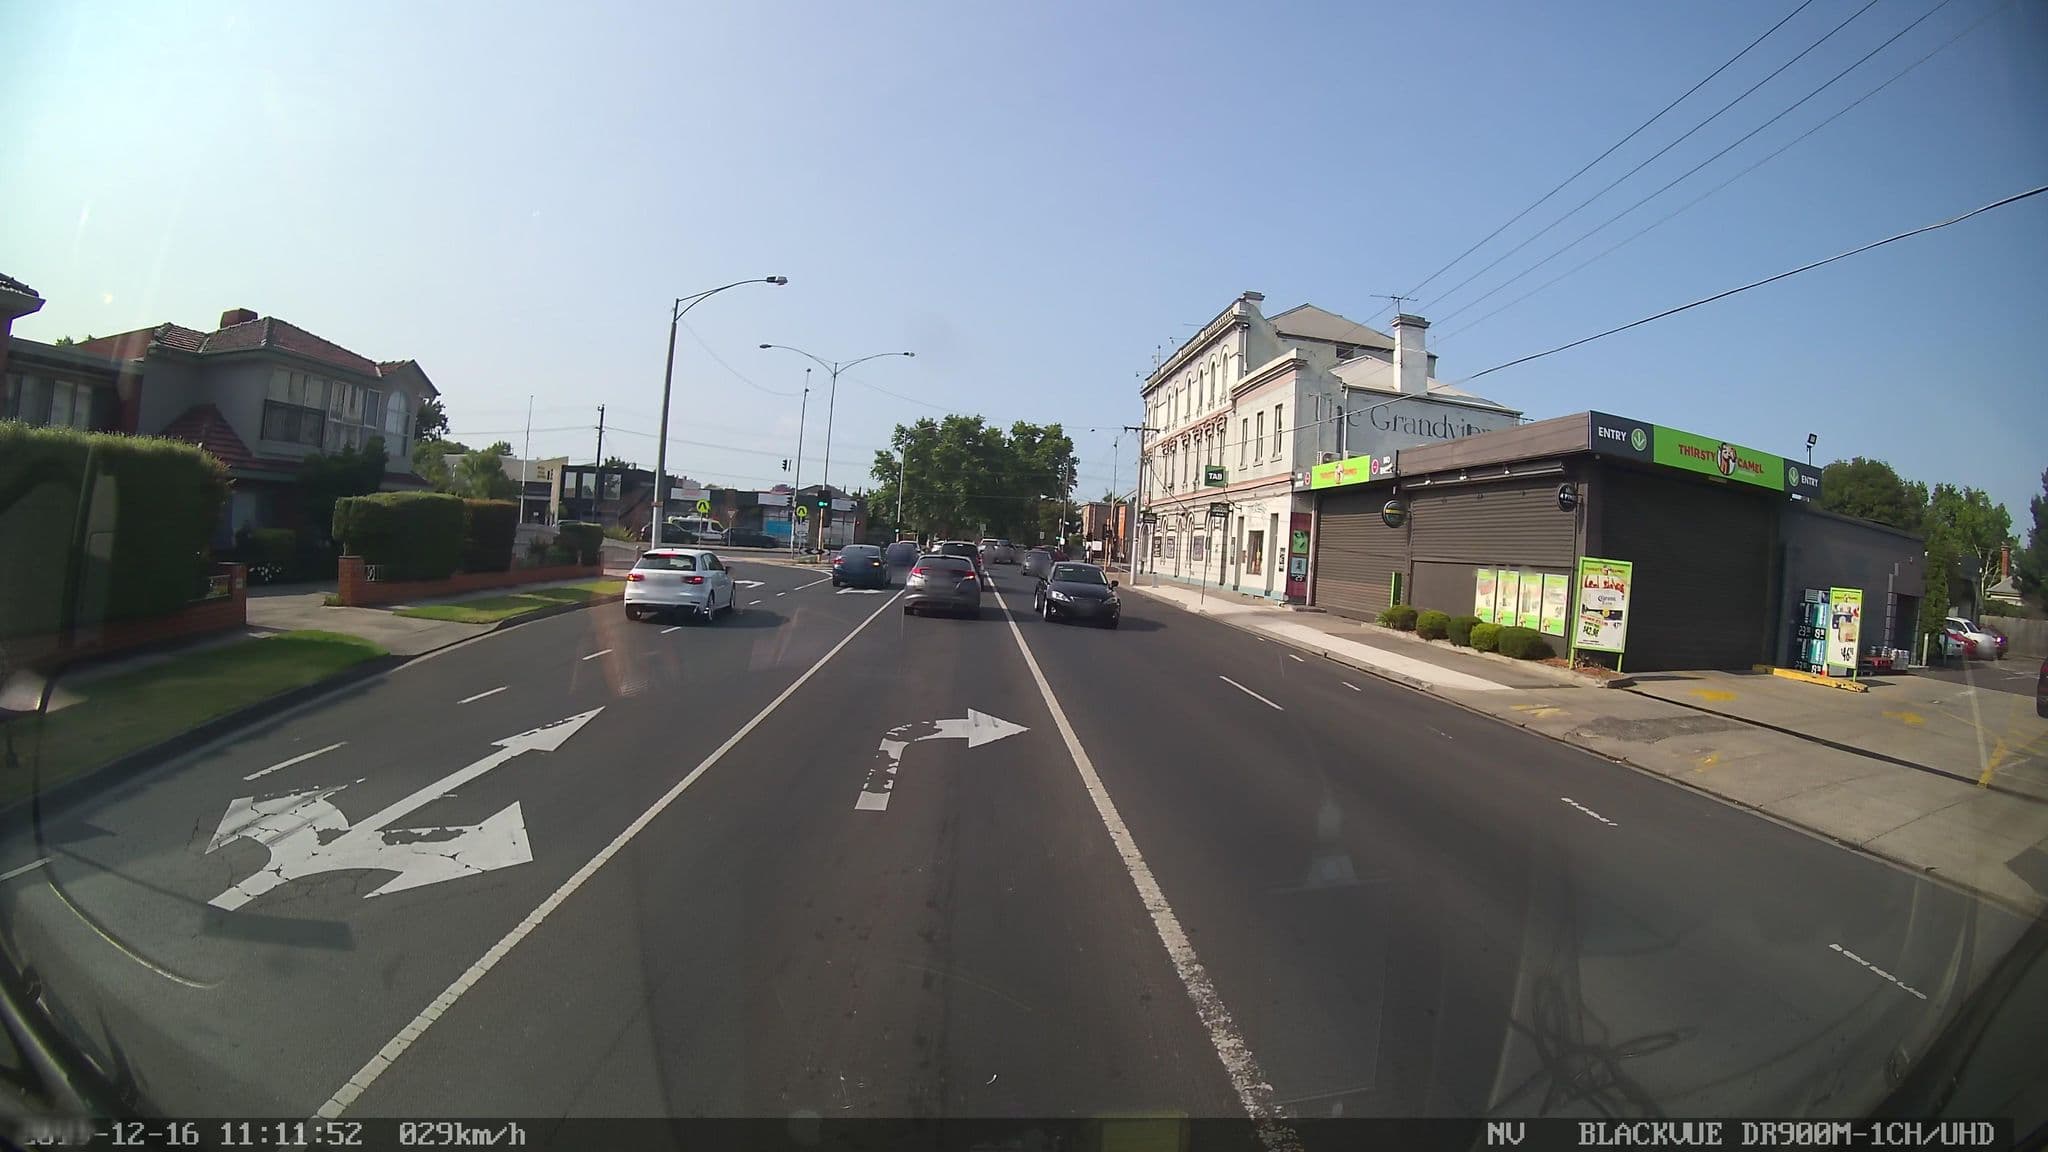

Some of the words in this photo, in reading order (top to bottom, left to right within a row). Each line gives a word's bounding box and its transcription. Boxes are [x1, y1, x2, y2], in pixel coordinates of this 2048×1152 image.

[1370, 405, 1492, 439] Grandvie
[1598, 427, 1627, 442] ENTRY
[1678, 444, 1716, 462] THIRSTY
[1737, 458, 1764, 474] CAMEL
[1208, 472, 1223, 481] TAB
[1801, 475, 1819, 488] ENTRY
